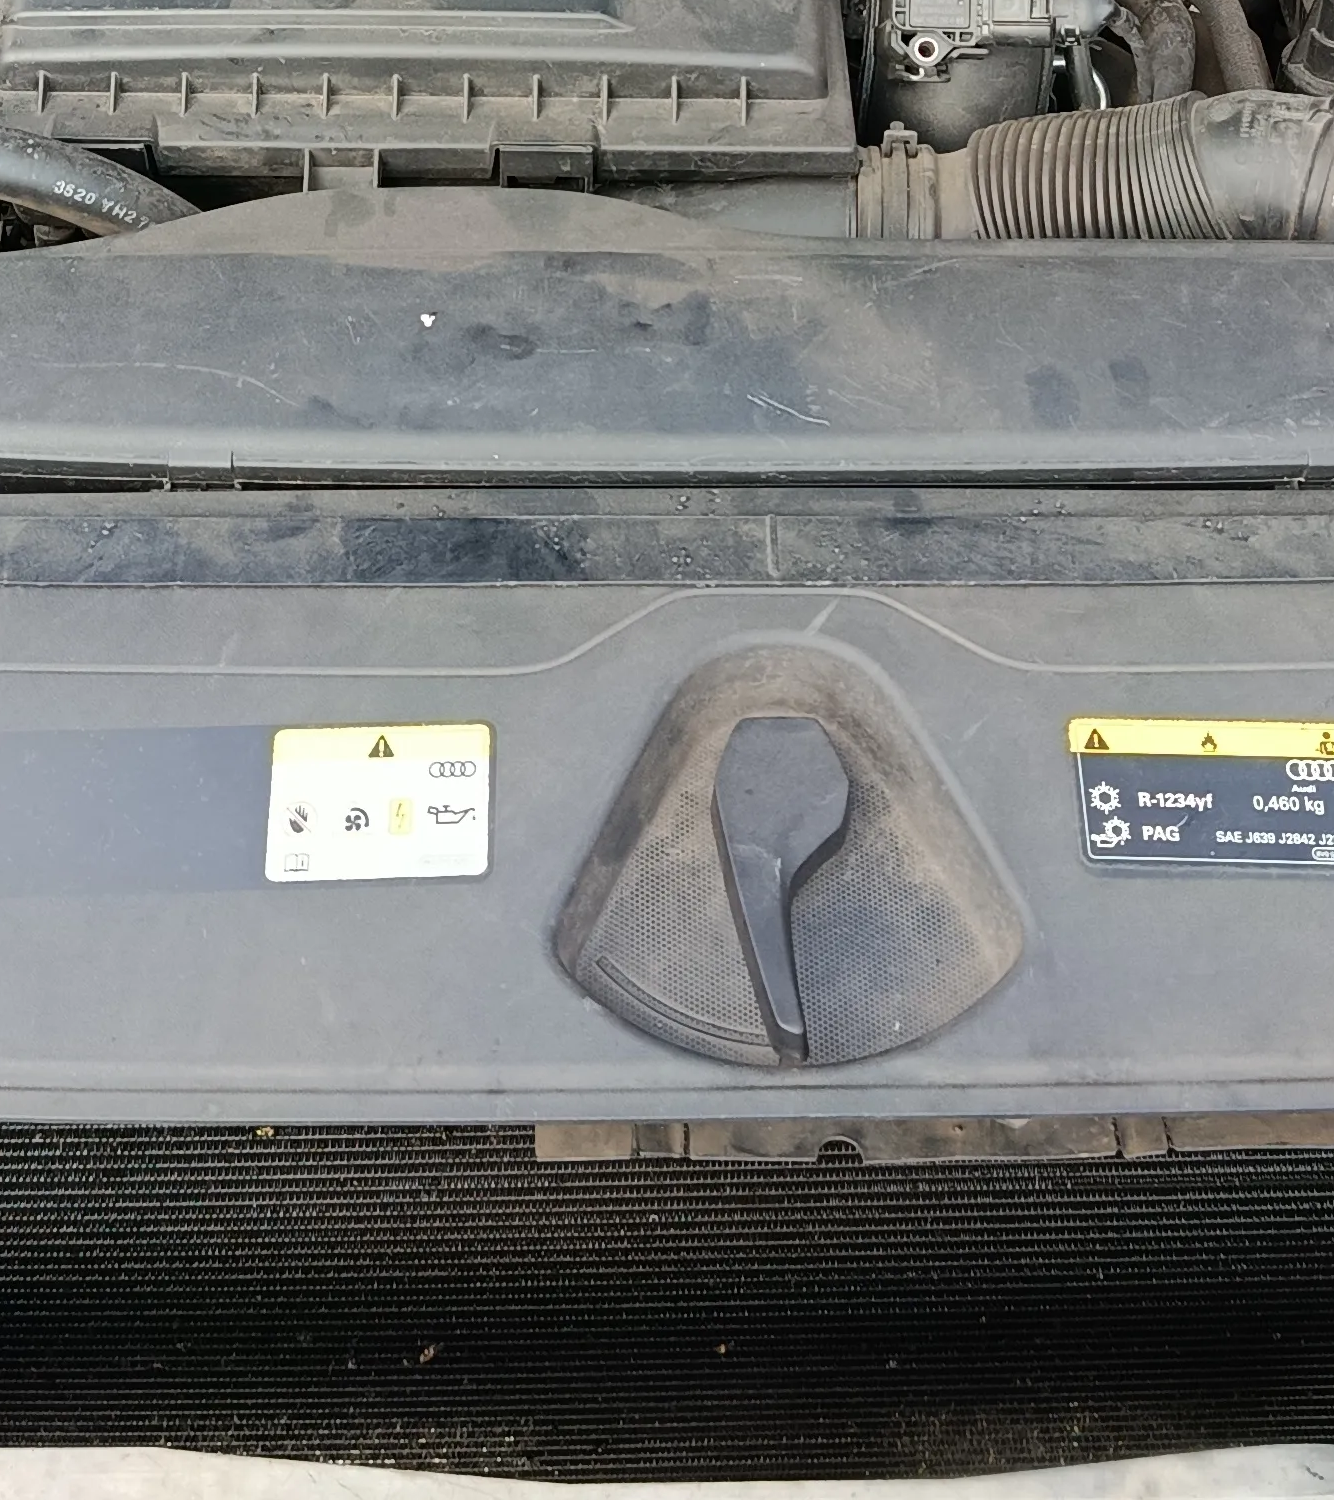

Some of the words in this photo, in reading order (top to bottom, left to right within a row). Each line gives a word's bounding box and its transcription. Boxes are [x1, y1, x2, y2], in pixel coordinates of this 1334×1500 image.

[1291, 784, 1317, 794] Audi
[1137, 791, 1213, 812] R-1234yf
[1252, 795, 1300, 812] 0,460
[1304, 795, 1325, 815] kg
[1141, 825, 1181, 842] PAG
[1216, 831, 1243, 844] SAE
[1244, 831, 1276, 845] J639
[1278, 832, 1316, 846] J2842
